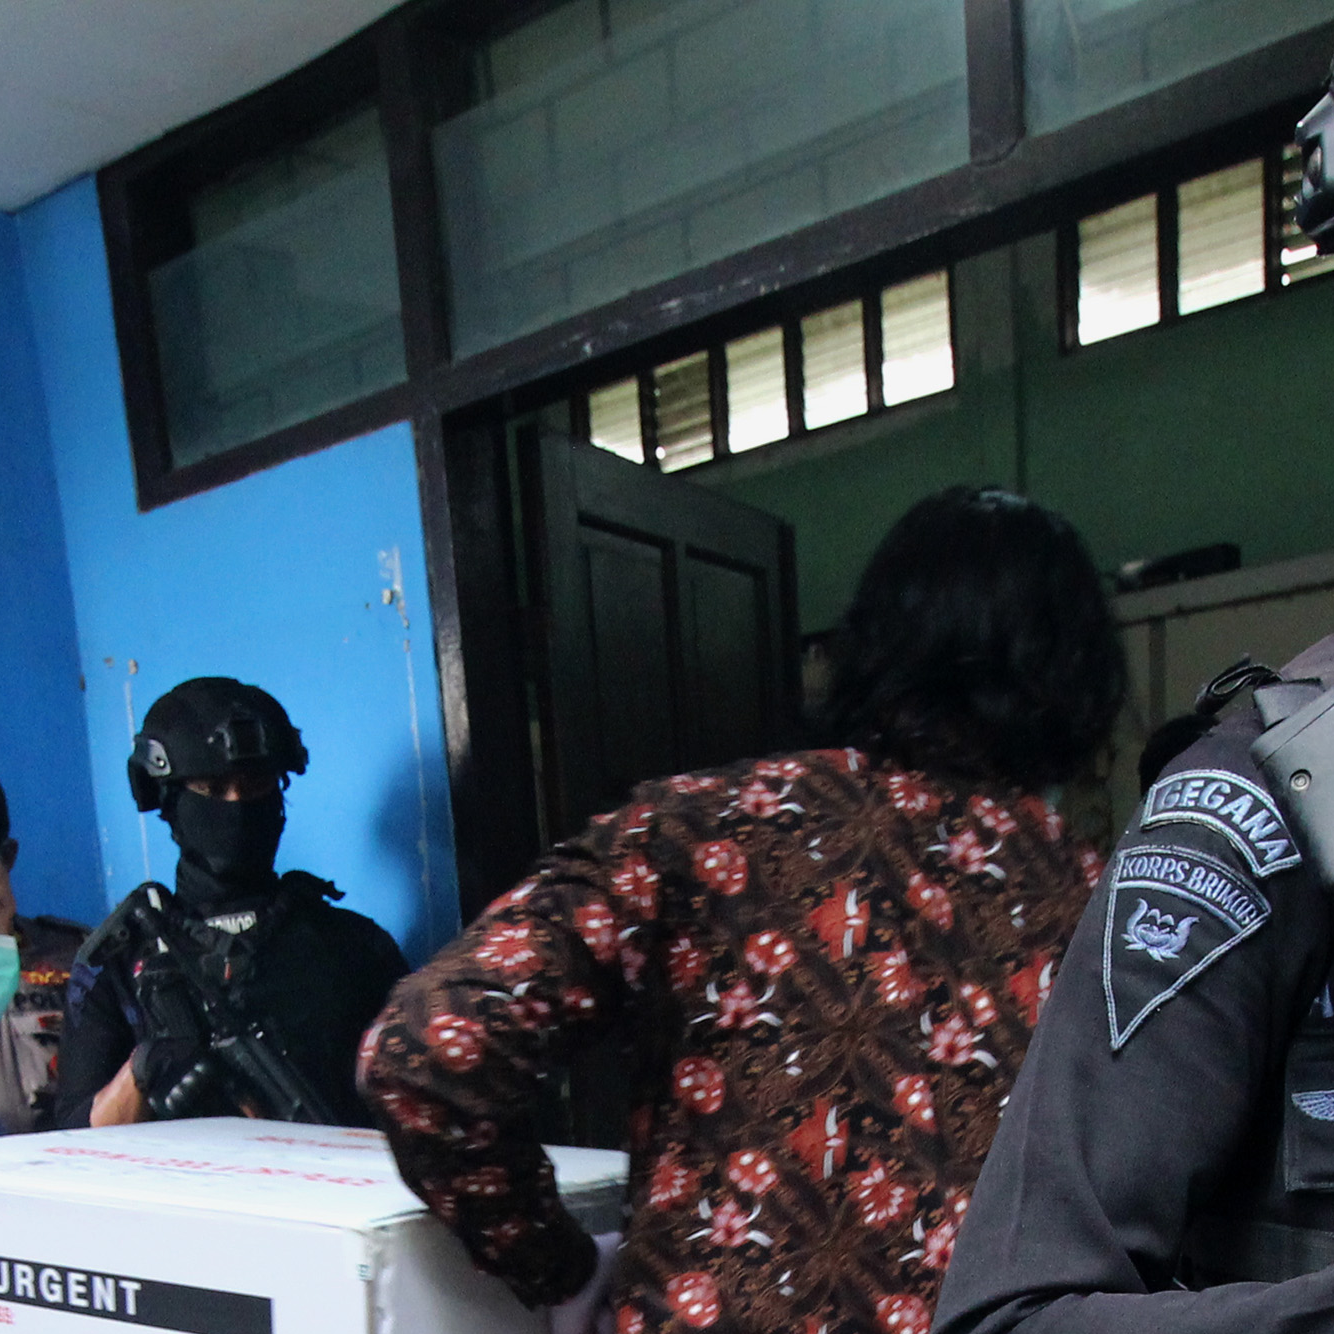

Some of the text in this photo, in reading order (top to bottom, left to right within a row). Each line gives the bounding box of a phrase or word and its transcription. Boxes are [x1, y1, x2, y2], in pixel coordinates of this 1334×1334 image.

[1157, 778, 1289, 862] GEGANA
[1123, 855, 1257, 926] KORPS BRIMOB
